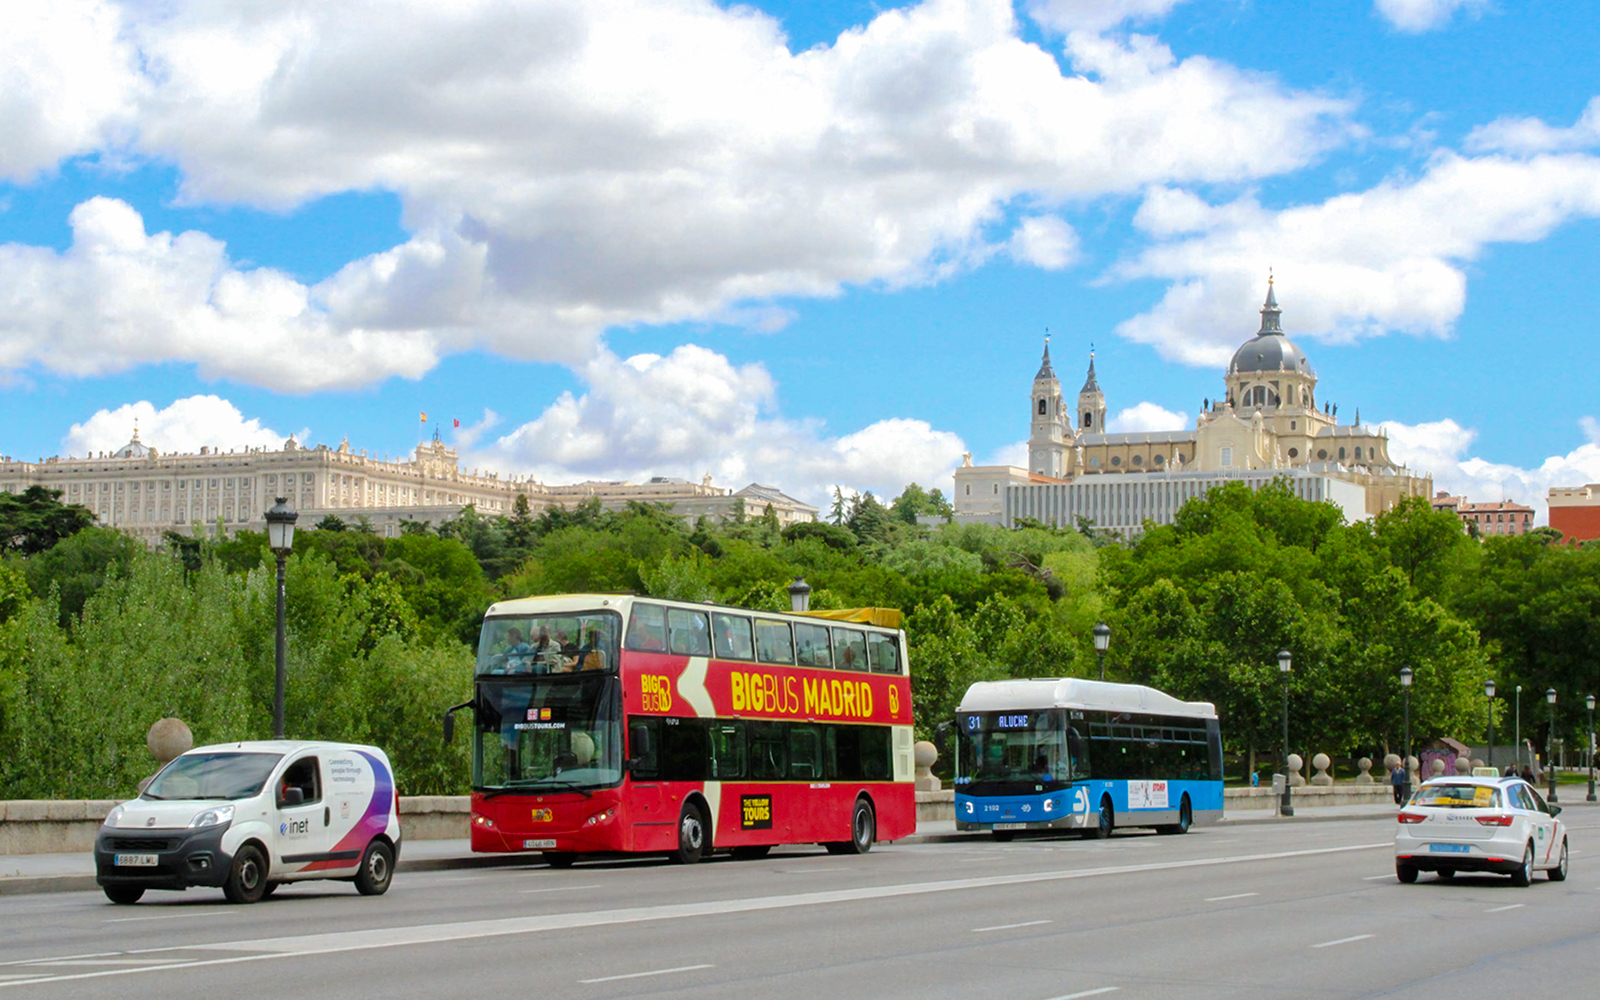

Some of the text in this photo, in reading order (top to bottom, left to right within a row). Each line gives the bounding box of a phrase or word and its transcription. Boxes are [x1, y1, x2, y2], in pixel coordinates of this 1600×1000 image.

[641, 674, 658, 693] BIG
[642, 694, 659, 711] BUS
[803, 677, 873, 717] MADRID
[968, 715, 1028, 729] 31 ALUCHE
[743, 807, 770, 820] TOURS
[289, 817, 309, 834] inet
